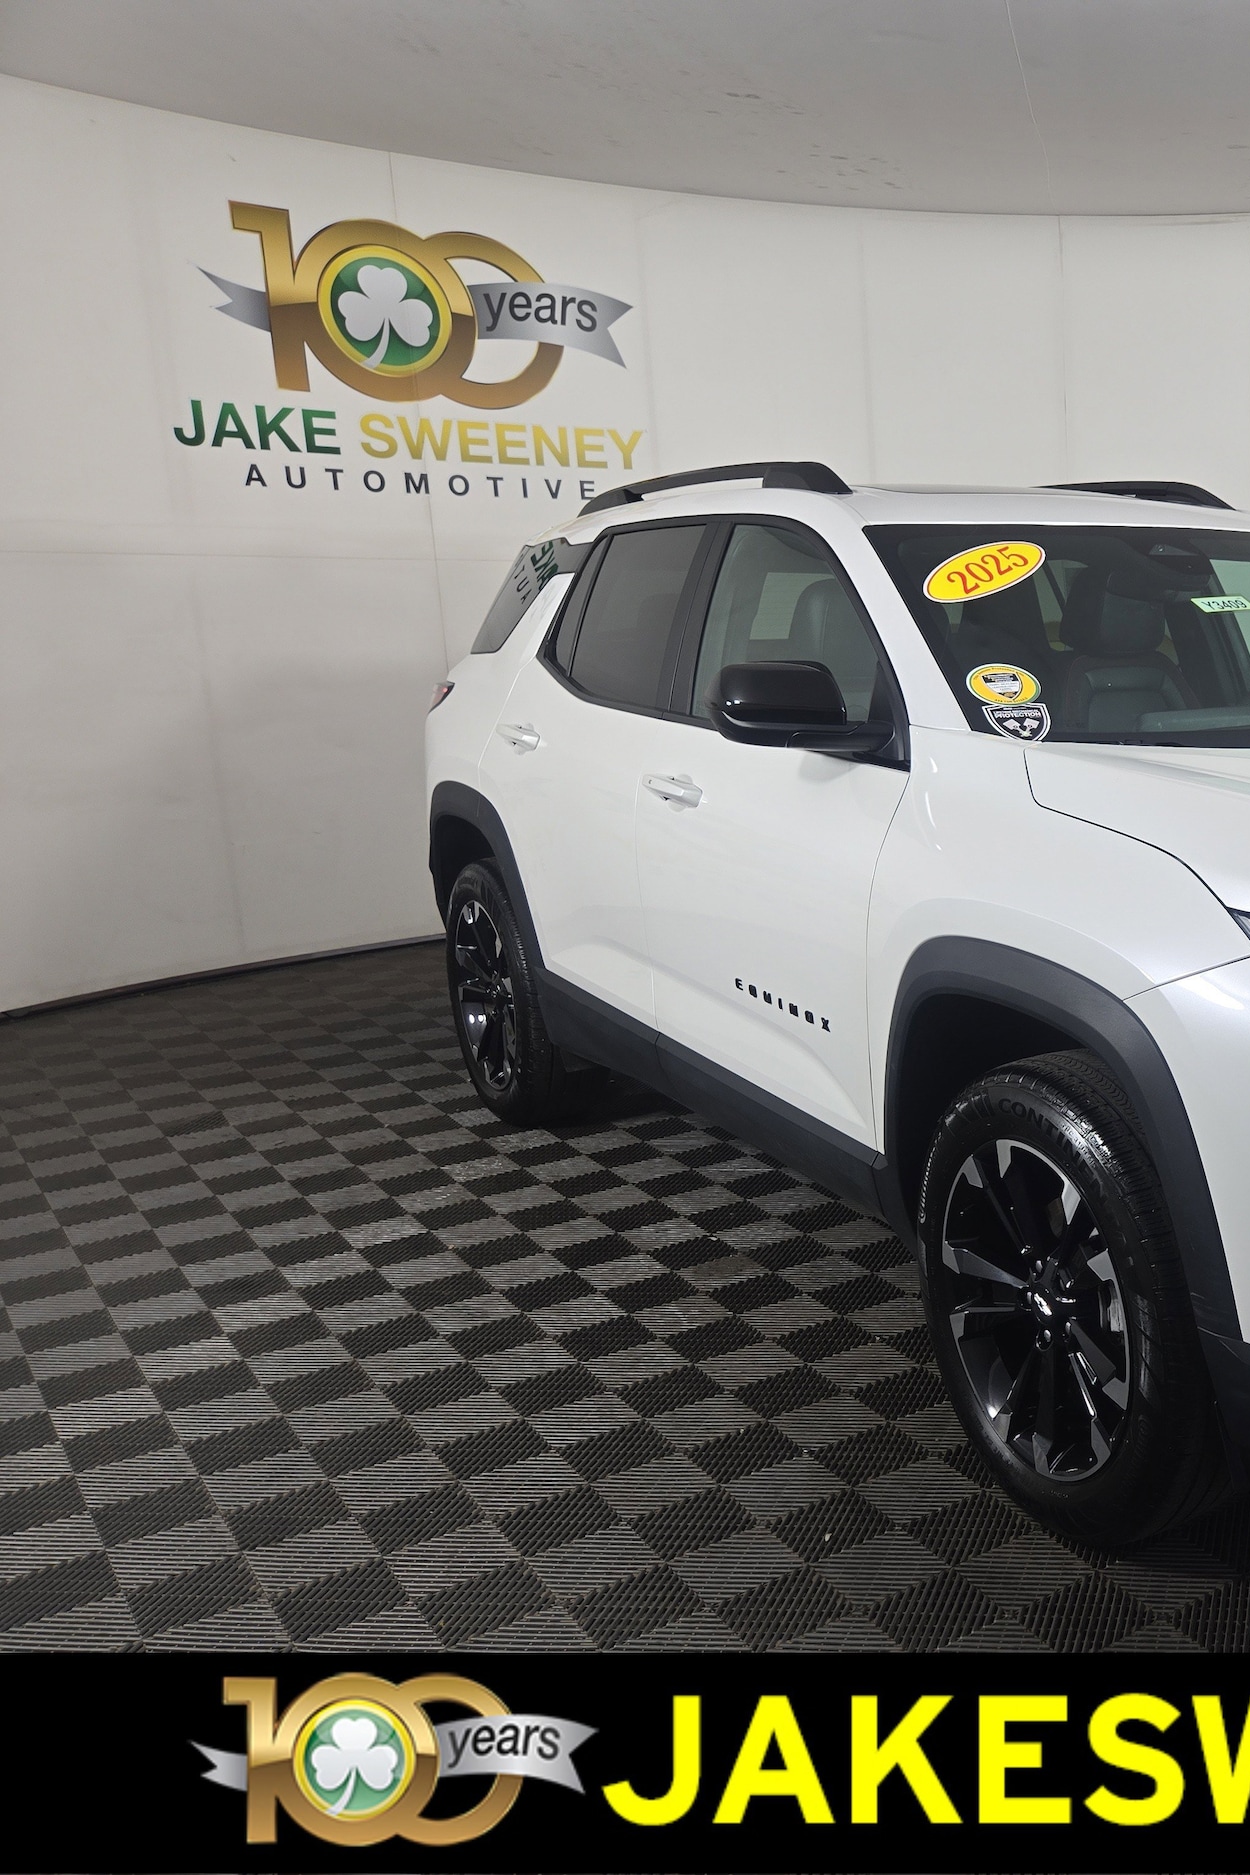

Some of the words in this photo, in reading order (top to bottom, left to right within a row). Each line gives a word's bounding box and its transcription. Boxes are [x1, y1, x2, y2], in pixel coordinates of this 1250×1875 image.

[228, 200, 564, 409] 100
[484, 291, 599, 333] years
[173, 400, 341, 455] JAKE
[360, 413, 644, 470] SWEENEY
[245, 463, 596, 500] AUTOMOTIVE
[946, 546, 1029, 595] 2025
[735, 978, 831, 1032] EQUINOX
